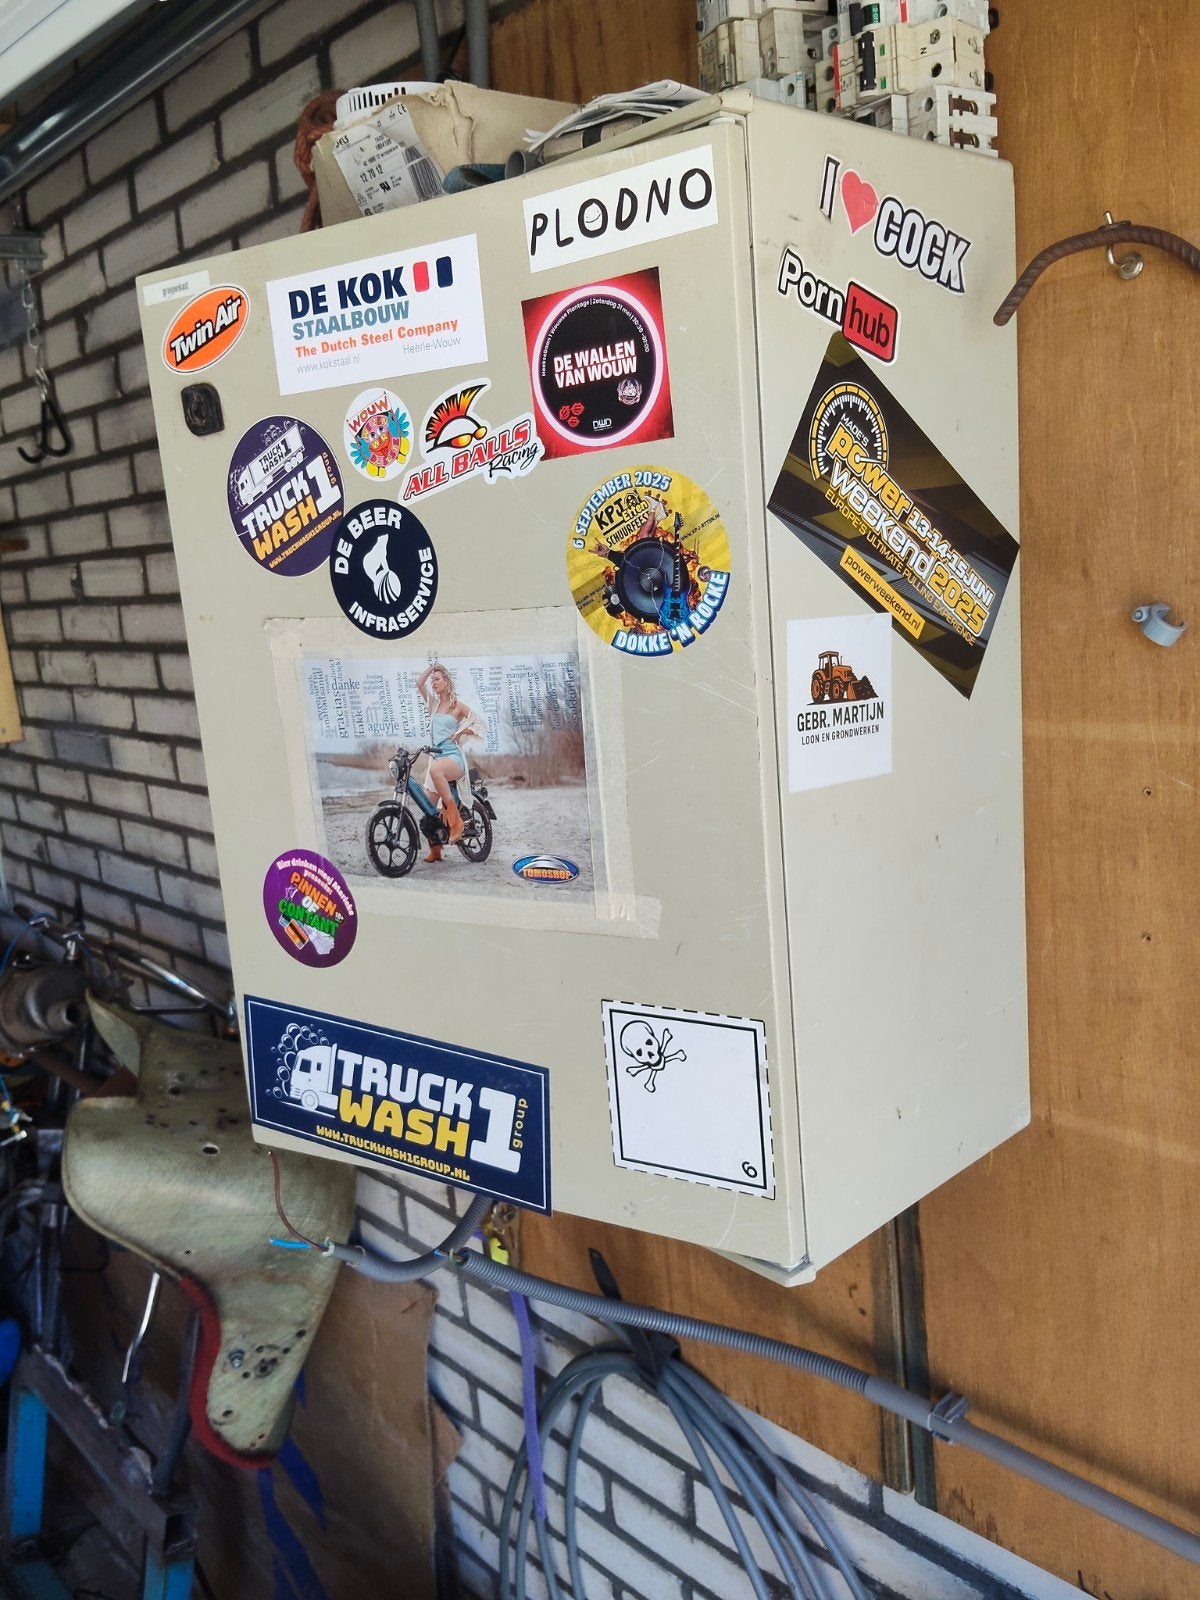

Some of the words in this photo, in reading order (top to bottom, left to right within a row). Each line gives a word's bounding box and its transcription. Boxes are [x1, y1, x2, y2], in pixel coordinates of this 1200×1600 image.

[529, 168, 712, 257] PLODNO
[819, 156, 841, 221] I
[873, 196, 971, 294] COCK
[288, 284, 329, 320] DE
[337, 266, 407, 309] KOK
[170, 320, 215, 364] Twin
[214, 297, 242, 334] Air
[292, 300, 410, 341] STAALBOUW
[295, 346, 317, 359] The
[321, 337, 357, 354] Dutch
[361, 329, 393, 346] Steel
[397, 319, 459, 339] Company
[296, 354, 360, 374] www.kokstaal.nl
[402, 336, 461, 355] Heerle-Wouw
[553, 354, 575, 374] DE
[574, 340, 636, 369] WALLEN
[554, 367, 586, 389] VAN
[586, 356, 638, 382] WOUW
[348, 395, 389, 433] WOUW
[840, 412, 869, 447] MADE'S
[258, 443, 283, 467] TRUCK
[262, 453, 286, 475] WASH
[403, 461, 449, 500] ALL
[451, 418, 531, 479] BALLS
[488, 442, 540, 479] Racing
[825, 422, 913, 521] power
[241, 470, 310, 539] TRUCK
[305, 454, 342, 514] 1
[634, 470, 673, 492] 2025
[574, 472, 633, 537] SEPTEMBER
[252, 495, 319, 561] WASH
[334, 538, 353, 574] DE
[347, 507, 402, 540] BEER
[572, 537, 586, 550] 6
[828, 459, 936, 587] weekend
[926, 560, 990, 638] 2025
[348, 546, 435, 633] INFRASERVICE
[825, 488, 868, 534] EUROPE'S
[866, 529, 904, 573] ULTIMATE
[902, 565, 935, 605] PULLING
[932, 596, 977, 648] EXPERIENCE
[613, 629, 672, 655] DOKKE
[689, 570, 731, 635] ROCKE
[843, 554, 922, 633] powerweekend.nl
[331, 678, 360, 691] danke
[334, 690, 349, 739] gracias
[355, 710, 365, 735] takk
[797, 709, 830, 733] GEBR.
[832, 701, 885, 727] MARTIJN
[801, 732, 820, 746] LOON
[821, 731, 831, 743] EN
[831, 724, 880, 742] GRONDWERKEN
[290, 871, 338, 917] PINNEN
[523, 868, 571, 880] TOMOSHOP
[278, 898, 339, 938] CONTANT
[301, 895, 320, 914] OF
[336, 1048, 474, 1120] TRUCK
[469, 1087, 523, 1173] 1
[338, 1088, 470, 1158] WASH
[511, 1097, 529, 1150] group
[315, 1124, 471, 1182] WWW.TRUCKWASH1GROUP.NL
[741, 1160, 758, 1178] 6
